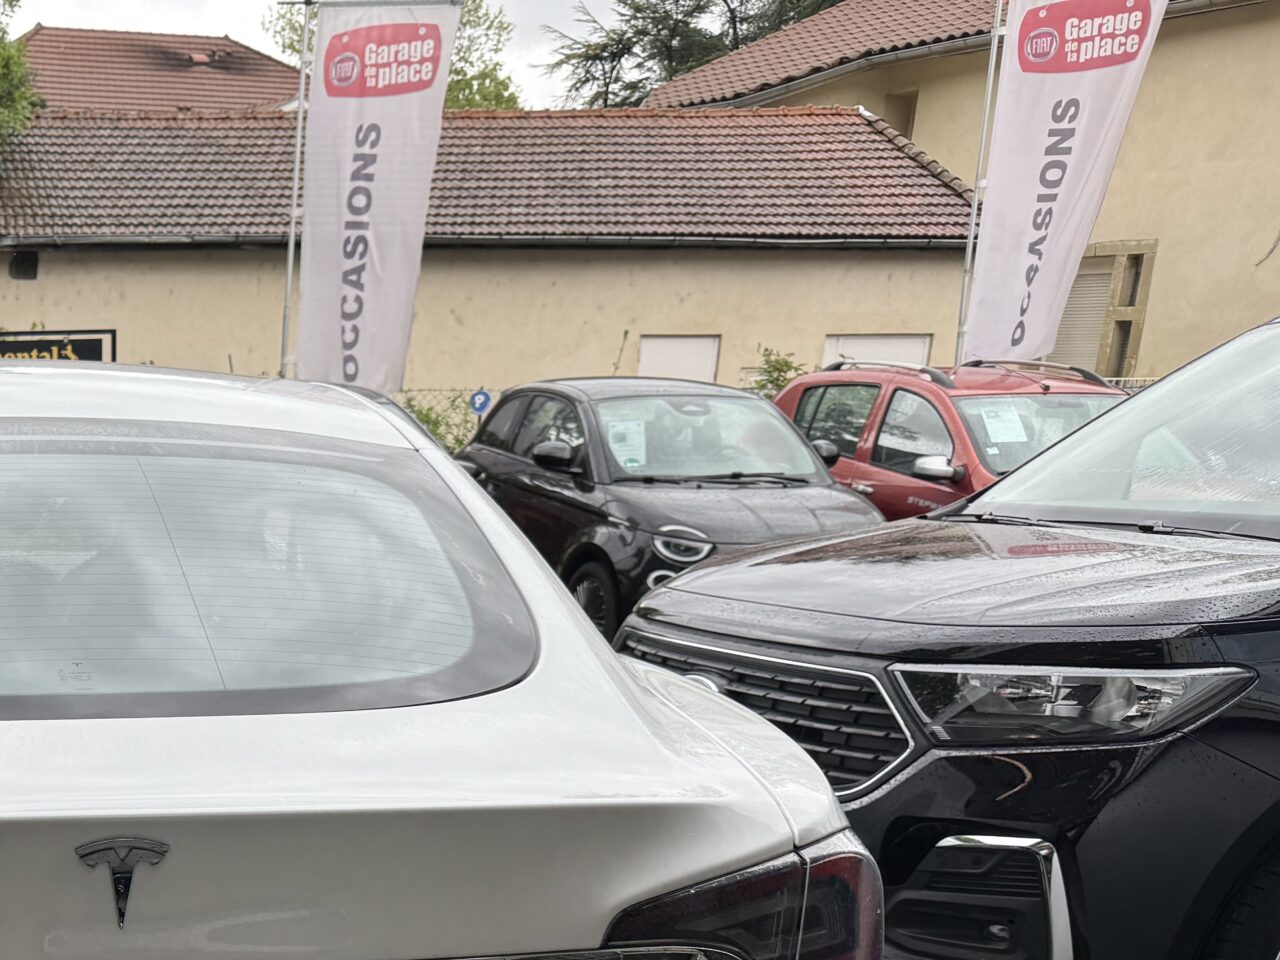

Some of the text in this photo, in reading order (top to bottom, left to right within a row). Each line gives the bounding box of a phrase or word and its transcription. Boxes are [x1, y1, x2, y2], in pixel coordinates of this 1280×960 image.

[1064, 11, 1143, 40] Garage
[364, 38, 435, 65] Garage
[1032, 37, 1052, 54] FIAT
[1065, 41, 1078, 52] de
[1067, 52, 1077, 63] la
[1079, 34, 1140, 63] place
[377, 61, 433, 88] place
[340, 122, 382, 383] OCCASIONS
